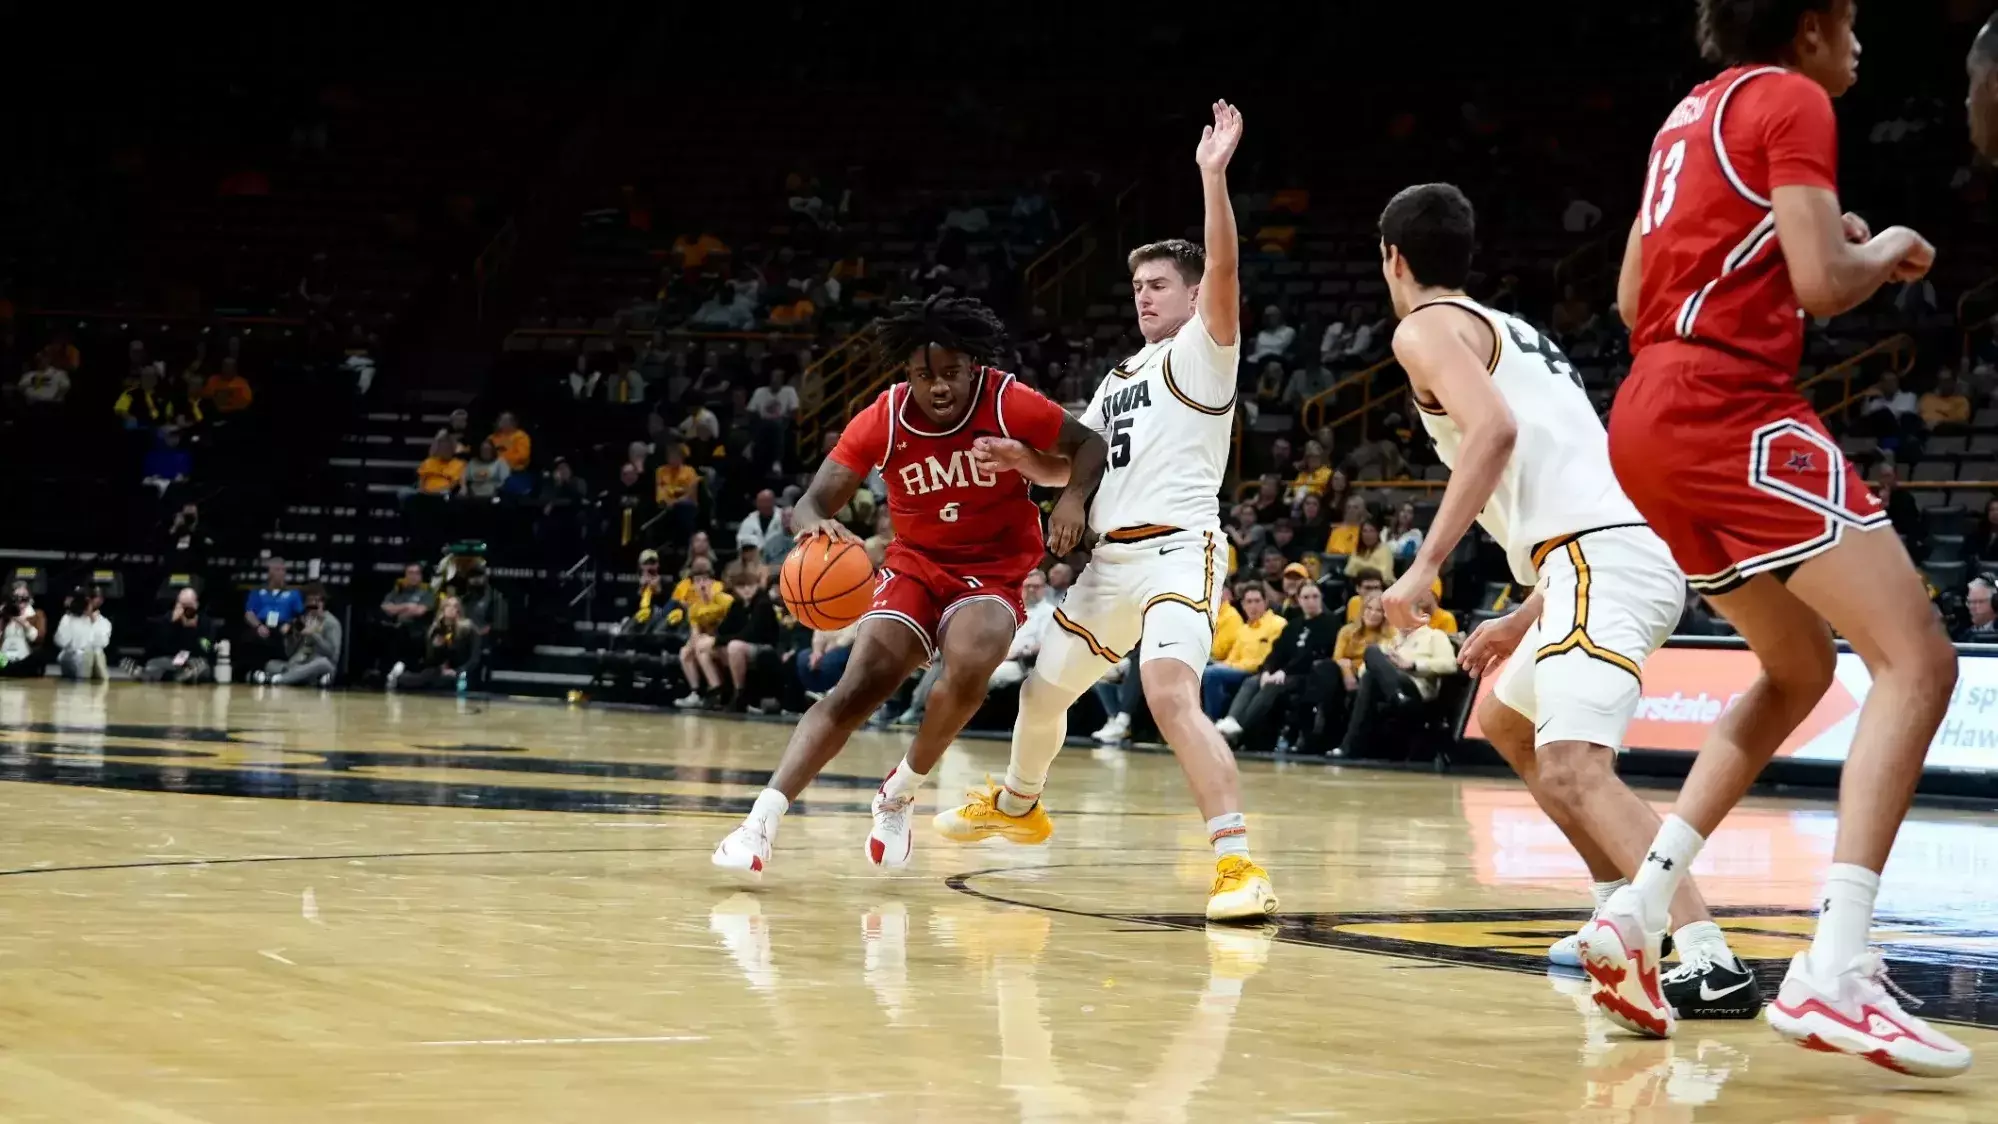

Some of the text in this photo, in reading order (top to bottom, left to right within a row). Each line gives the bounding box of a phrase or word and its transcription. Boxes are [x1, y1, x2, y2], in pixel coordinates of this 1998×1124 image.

[1641, 138, 1686, 236] 13
[1101, 379, 1152, 428] OWA
[1106, 417, 1135, 473] 5
[939, 501, 961, 523] 6
[1633, 690, 1723, 724] rstate
